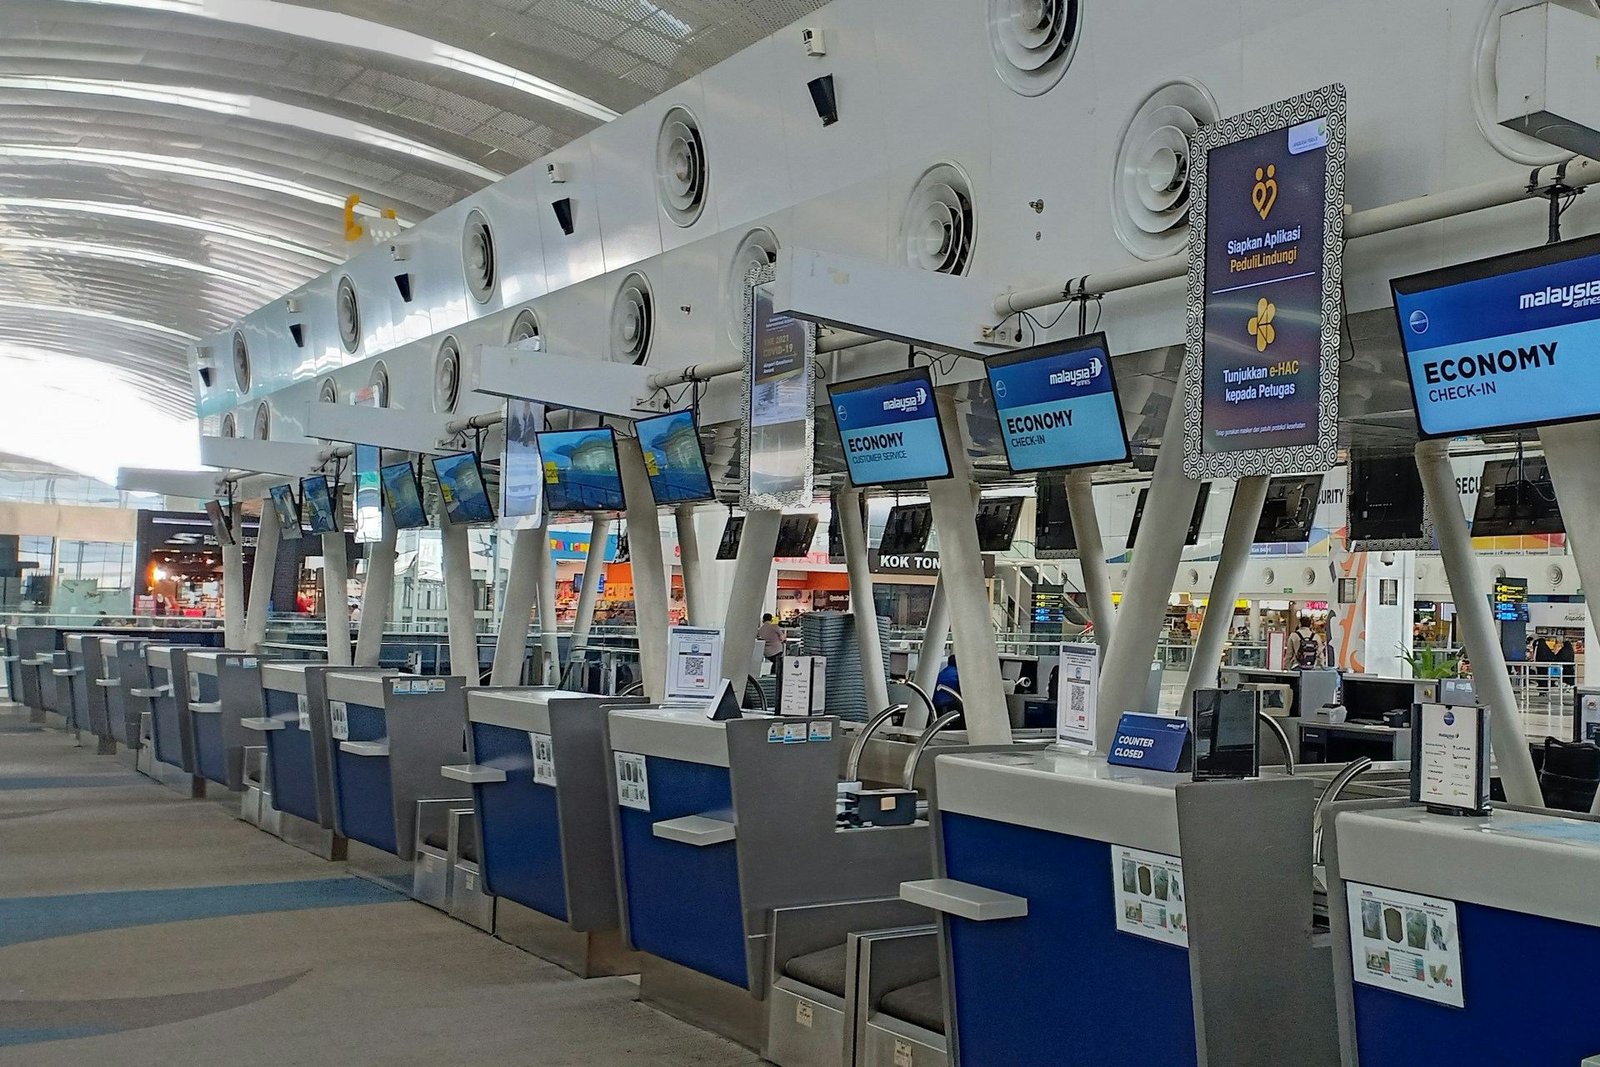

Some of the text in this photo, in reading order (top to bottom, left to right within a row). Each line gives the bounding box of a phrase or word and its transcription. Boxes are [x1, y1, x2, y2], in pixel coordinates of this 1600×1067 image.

[1227, 225, 1301, 255] Siapkan Aplikasi
[1230, 247, 1297, 273] PeduliLindungi
[1519, 280, 1600, 310] malaysia
[1223, 360, 1299, 384] Tunjukkan e-HAC
[1423, 342, 1558, 384] ECONOMY
[1049, 368, 1090, 386] malaysia
[1225, 383, 1296, 404] kepada Petugas
[1429, 381, 1497, 403] CHECK-IN
[883, 396, 917, 411] malaysia
[1006, 409, 1073, 434] ECONOMY
[848, 432, 903, 453] ECONOMY
[1011, 434, 1046, 448] CHECK-IN
[853, 450, 907, 464] CUSTOMER SERVICE
[880, 555, 909, 568] KOK
[1118, 735, 1154, 747] COUNTER
[1114, 747, 1144, 759] CLOSED
